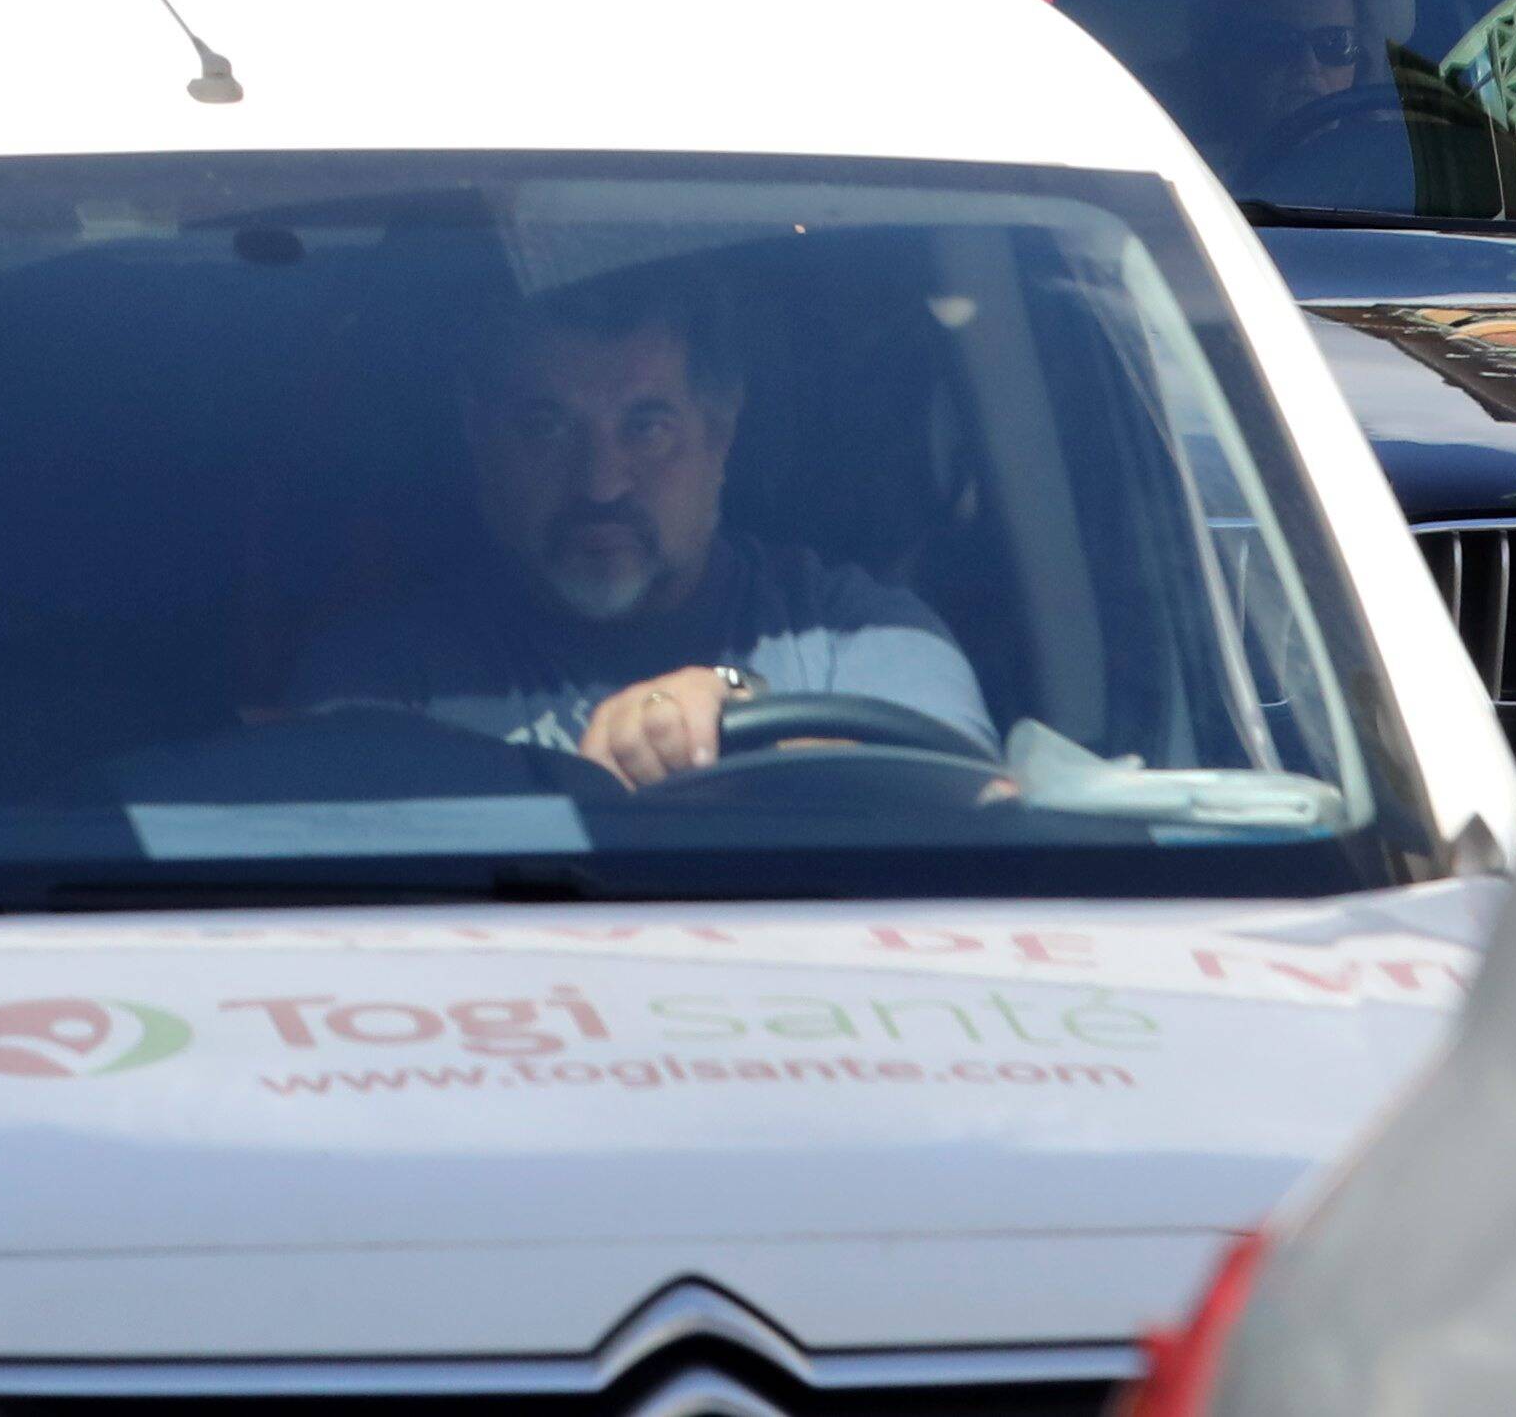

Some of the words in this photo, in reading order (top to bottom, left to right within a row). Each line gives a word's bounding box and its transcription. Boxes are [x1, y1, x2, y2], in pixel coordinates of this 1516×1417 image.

[218, 983, 611, 1057] Togi
[650, 985, 1165, 1051] santé
[261, 1057, 1136, 1096] www.togisante.com
